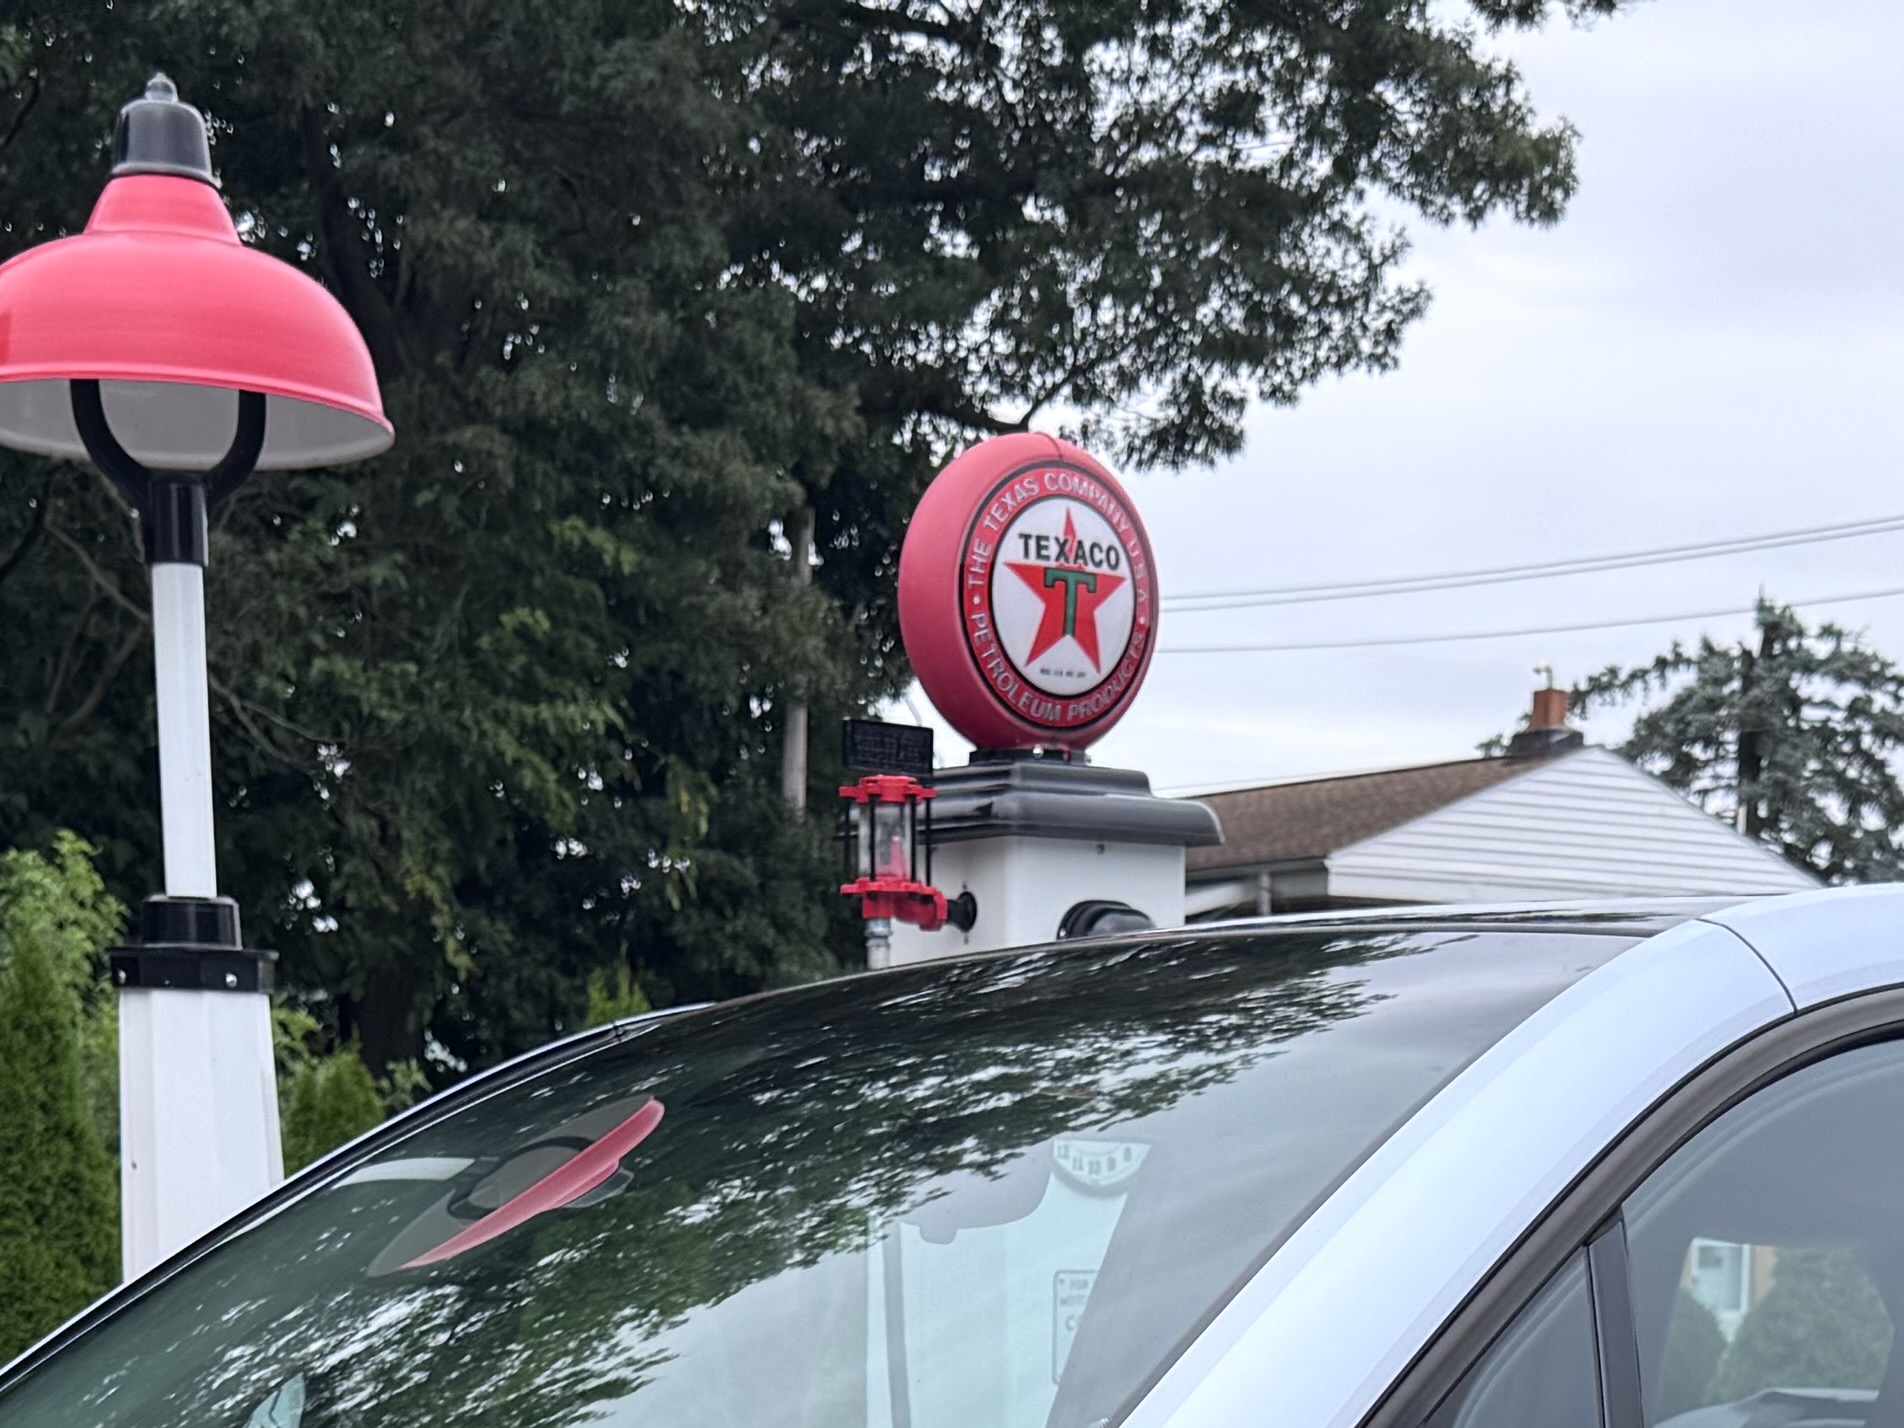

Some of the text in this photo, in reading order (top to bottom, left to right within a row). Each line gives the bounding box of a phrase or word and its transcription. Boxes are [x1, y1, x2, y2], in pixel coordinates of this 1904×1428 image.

[968, 538, 988, 588] THE
[984, 477, 1040, 531] TEXAS
[1043, 472, 1129, 533] COMPANY
[1018, 533, 1120, 571] TEXACO
[971, 611, 1062, 722] PETROLEUM
